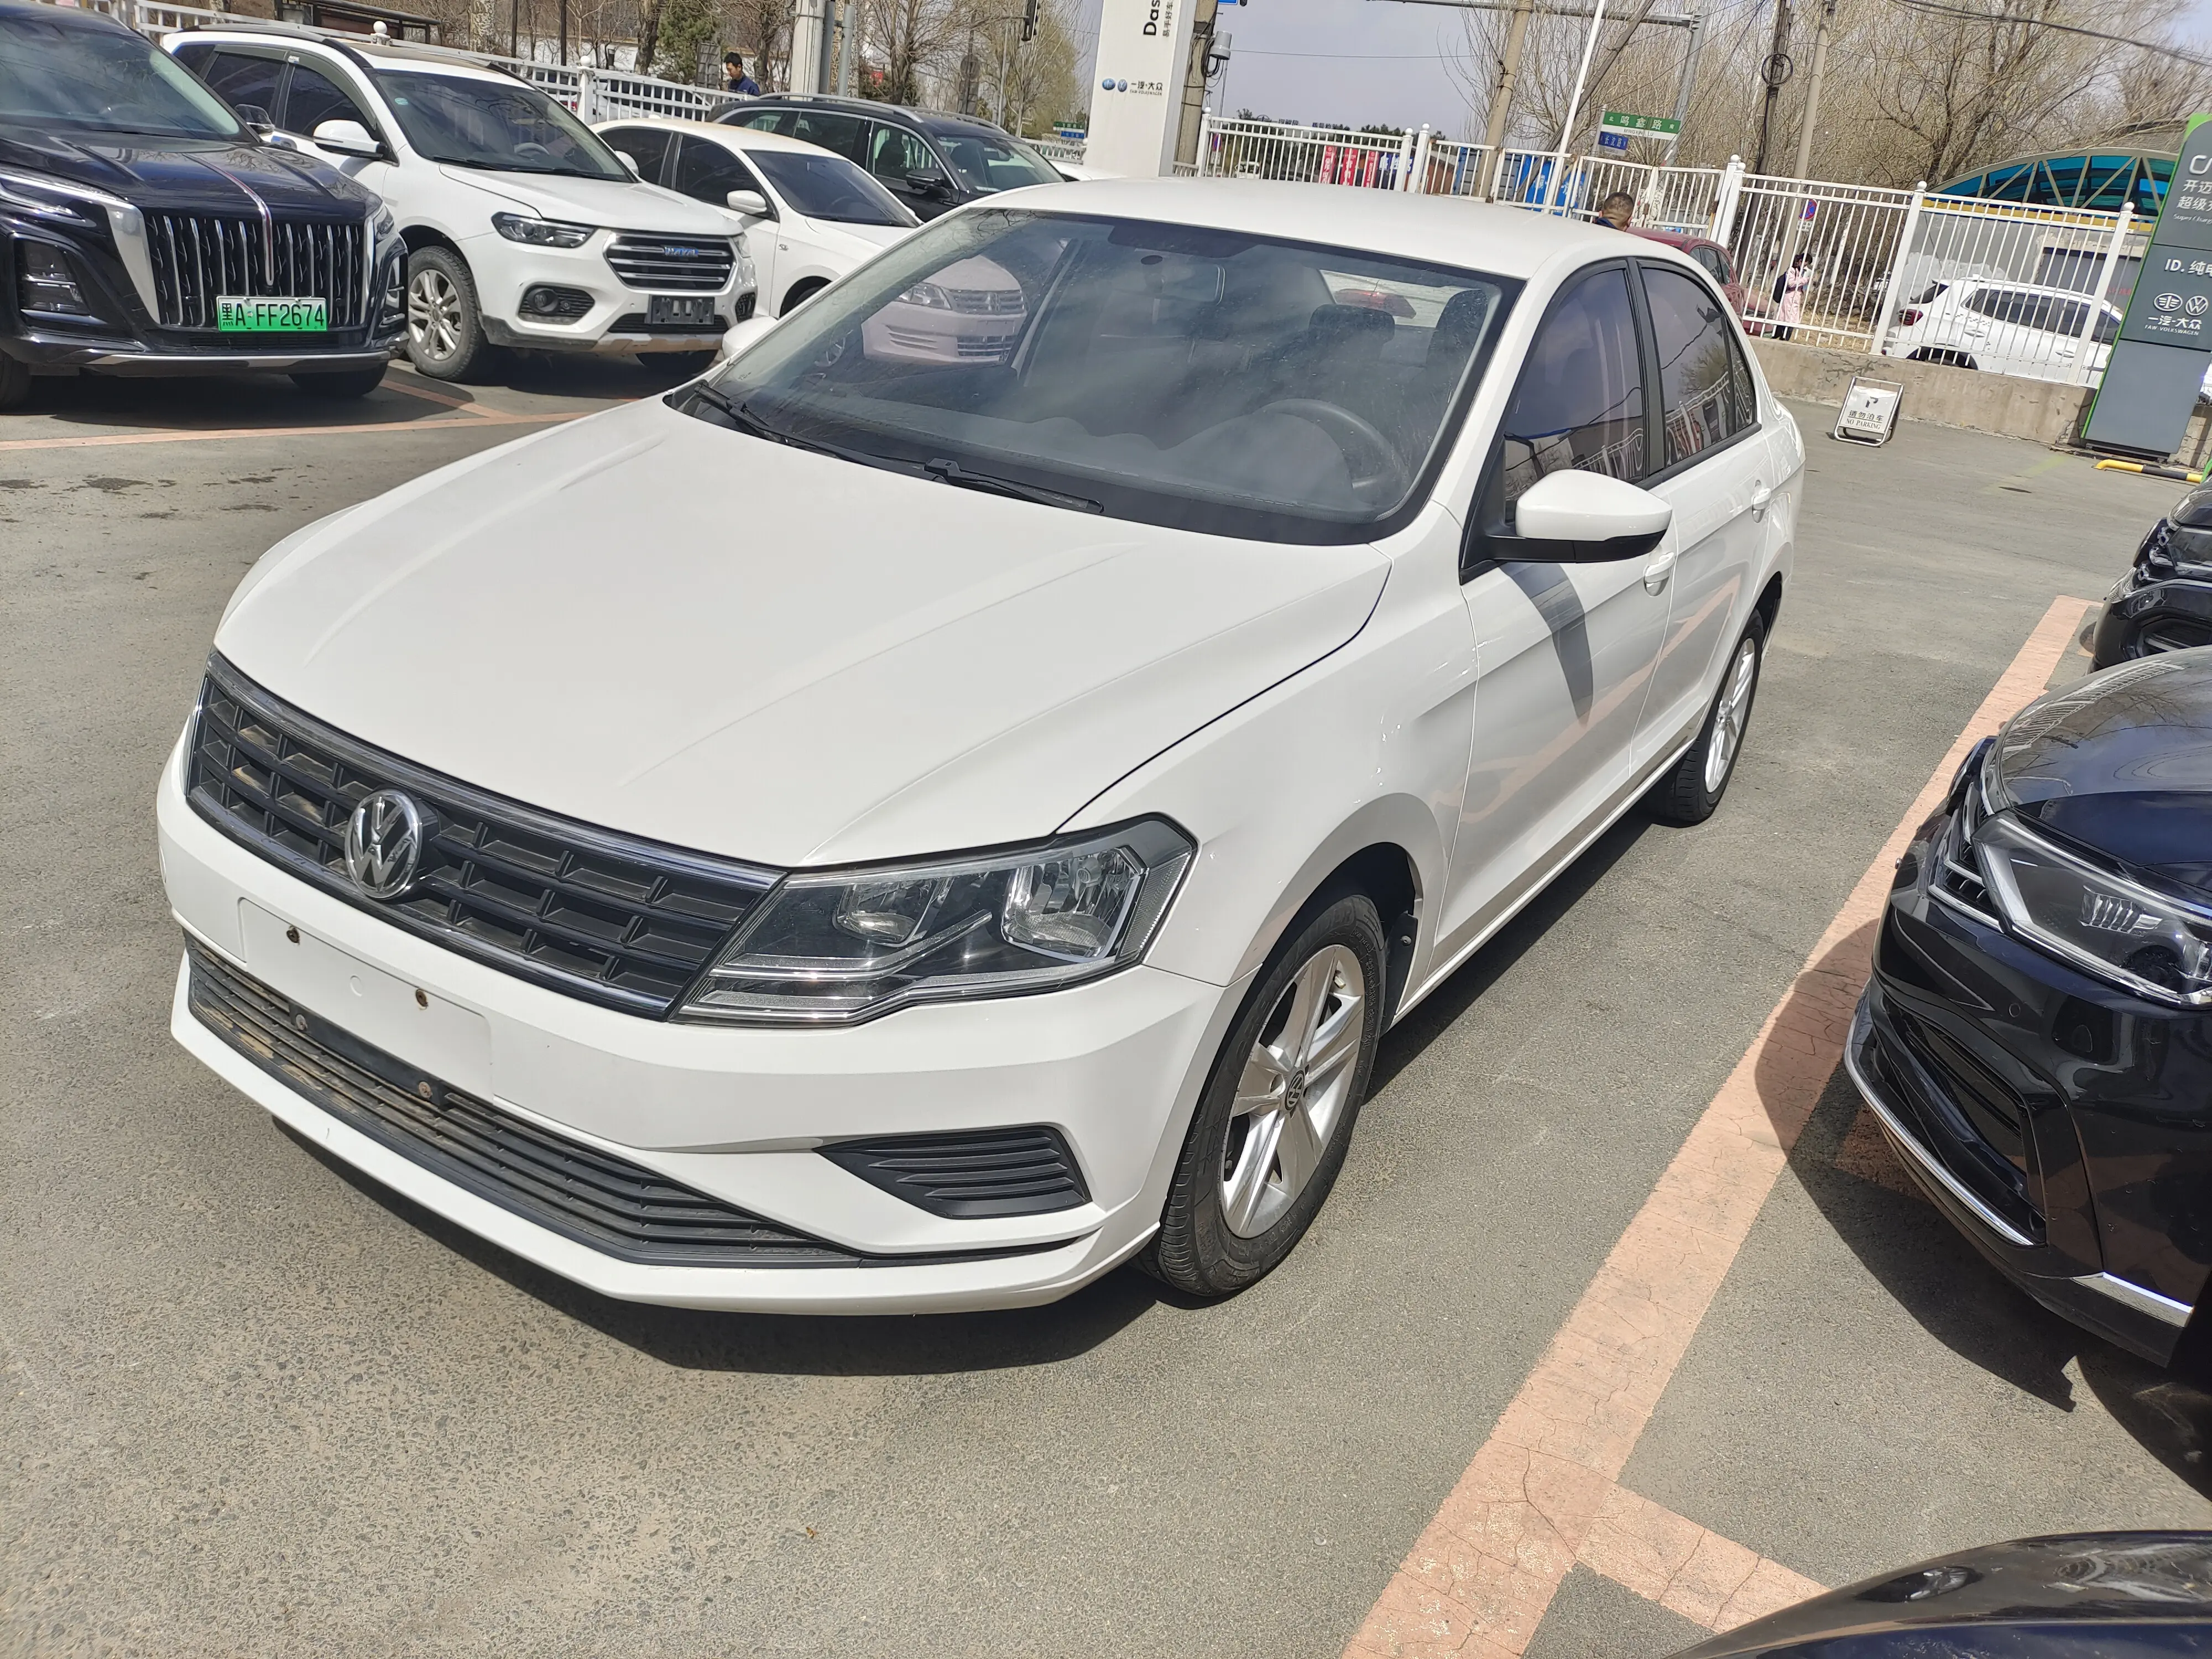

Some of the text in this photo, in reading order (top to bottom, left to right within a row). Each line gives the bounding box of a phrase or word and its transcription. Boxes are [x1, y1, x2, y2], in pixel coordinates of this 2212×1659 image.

[1143, 0, 1160, 35] Das
[1620, 116, 1662, 131] 鸣鑫路
[2164, 259, 2185, 273] ID.
[1849, 410, 1884, 421] 请勿泊车
[1856, 420, 1881, 430] PARKING
